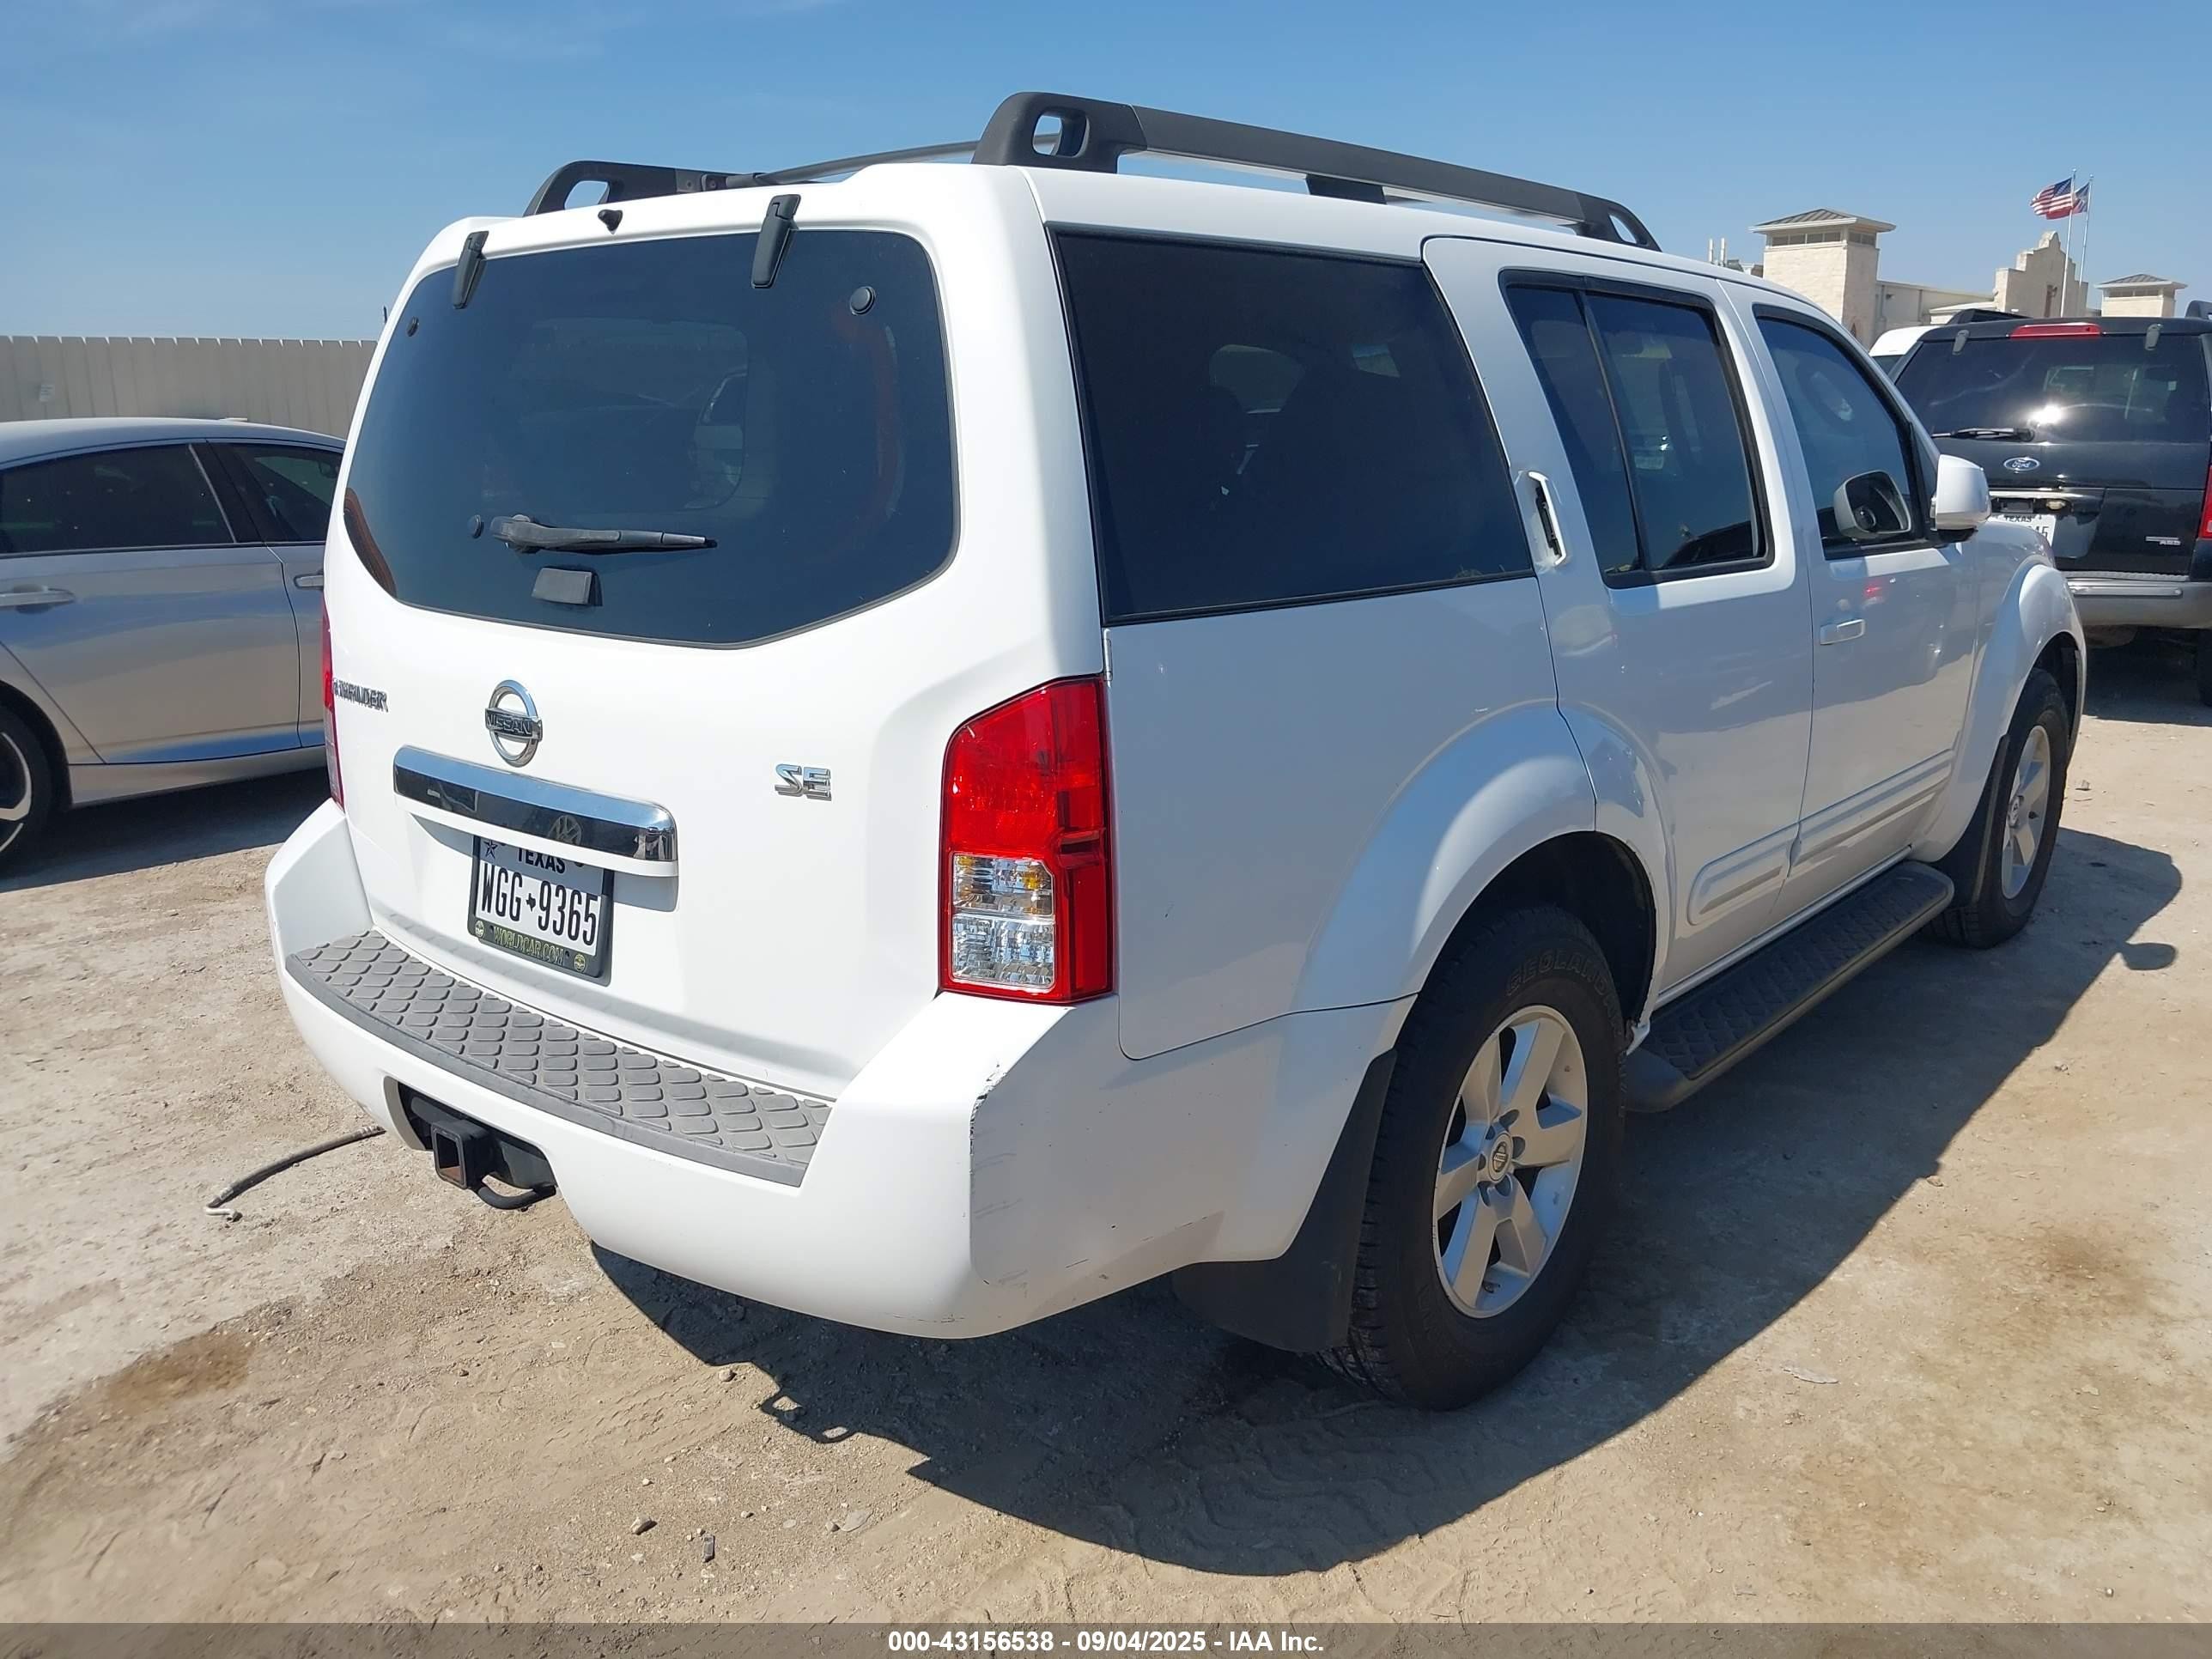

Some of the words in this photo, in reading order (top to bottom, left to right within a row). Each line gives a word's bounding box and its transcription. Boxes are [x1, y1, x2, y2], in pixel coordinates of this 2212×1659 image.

[332, 678, 389, 713] ATHFINDER
[485, 712, 533, 737] NISSAN
[775, 763, 832, 802] SE
[516, 846, 567, 875] TEXAS
[481, 862, 523, 922] WGG
[538, 880, 599, 946] 9365
